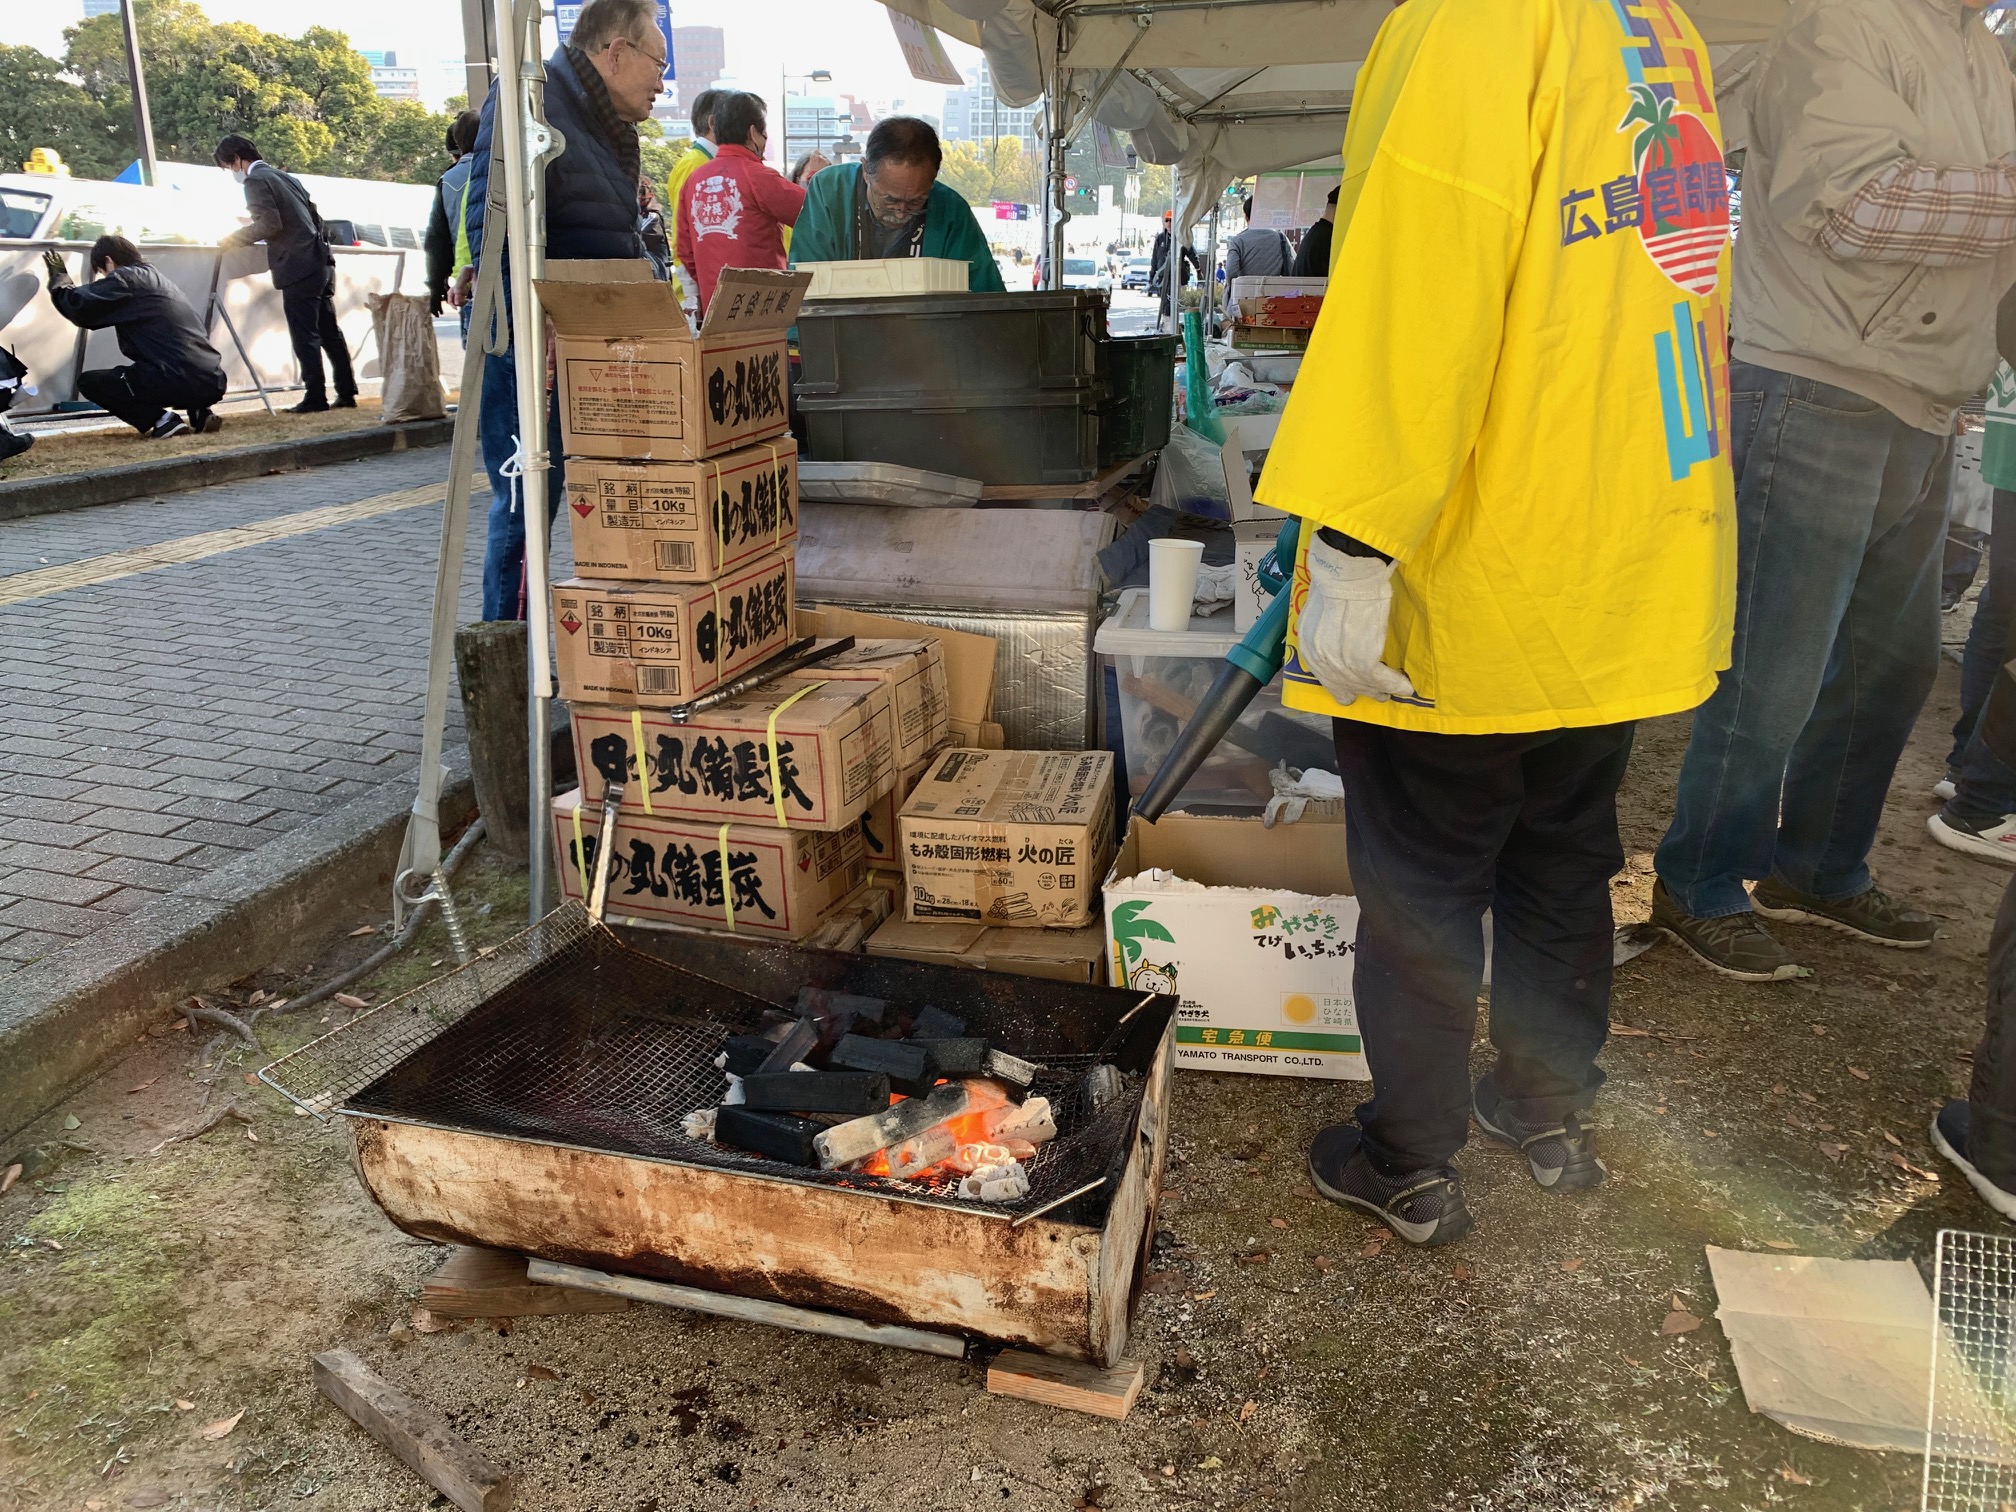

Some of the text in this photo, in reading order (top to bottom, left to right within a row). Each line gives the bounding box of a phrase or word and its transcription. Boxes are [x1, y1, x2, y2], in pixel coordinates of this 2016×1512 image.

[1560, 161, 1727, 247] 広島宮崎県
[652, 499, 685, 512] 10Kg
[606, 514, 641, 527] 製造元
[637, 625, 673, 639] 10Kg
[593, 641, 628, 655] 製造元
[909, 843, 1076, 865] もみ殻固形燃料 火の匠
[1250, 904, 1340, 940] みやざき
[1323, 998, 1352, 1007] 日本の
[1178, 1010, 1210, 1018] やざき犬
[1323, 1008, 1352, 1017] ひなた
[1201, 1028, 1273, 1046] 宅急便
[1177, 1049, 1324, 1066] YAMATO TRANSPORT CO.,LTD.
